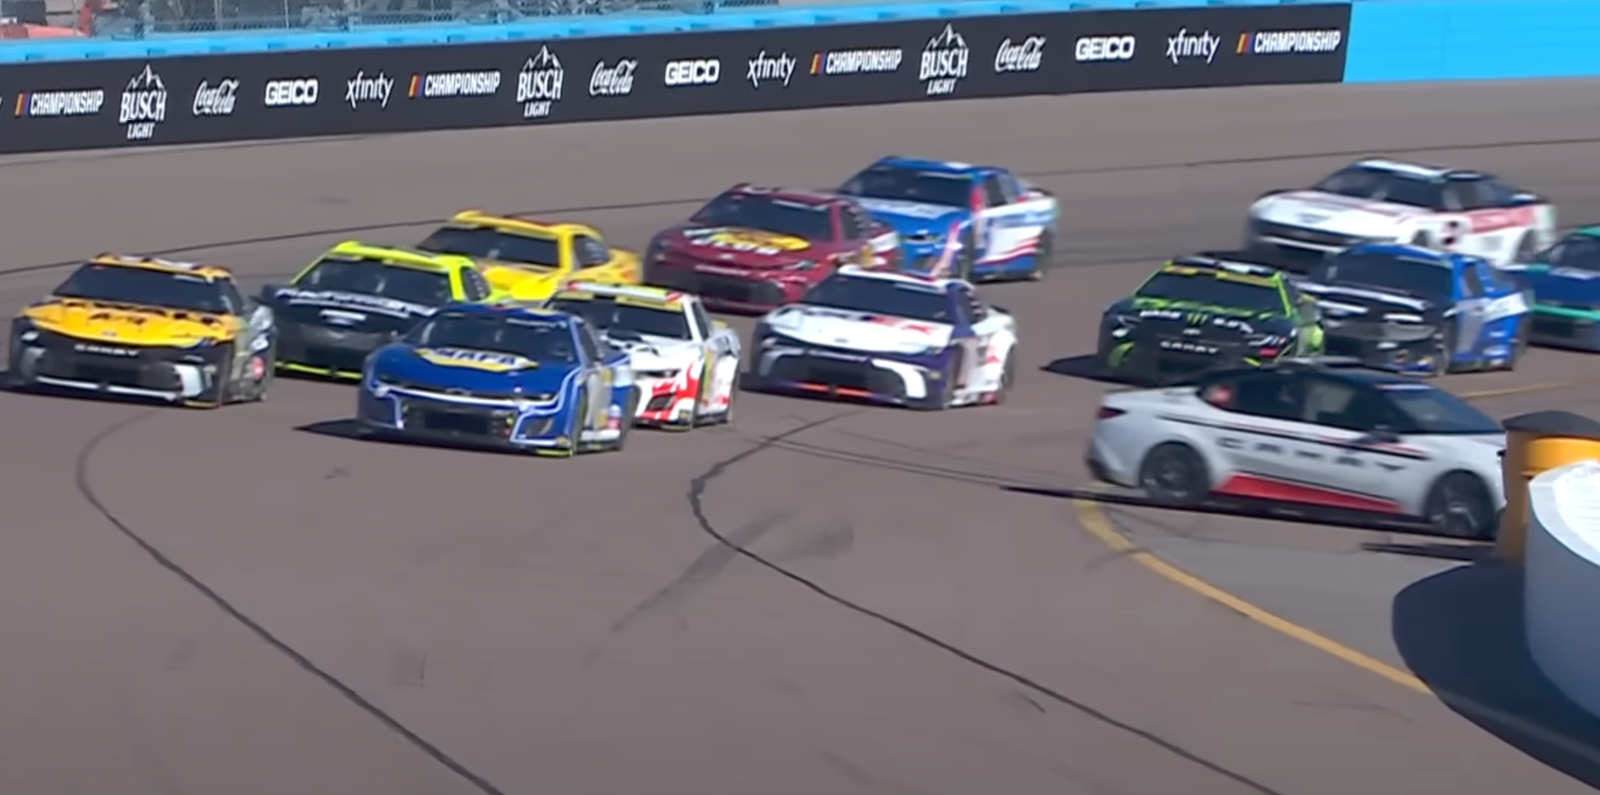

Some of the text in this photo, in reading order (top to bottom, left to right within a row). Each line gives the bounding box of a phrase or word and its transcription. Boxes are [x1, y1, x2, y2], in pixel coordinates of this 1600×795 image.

[1074, 35, 1136, 61] GEICO
[1165, 28, 1221, 65] xfinity
[1253, 30, 1342, 54] CHAMPIONSHIP
[664, 59, 721, 86] GEICO
[746, 50, 797, 88] xfinity
[825, 48, 903, 75] CHAMPIONSHIP
[918, 48, 970, 80] BUSCH
[264, 78, 319, 106] GEICO
[345, 70, 394, 109] xfinity
[424, 70, 501, 97] CHAMPIONSHIP
[516, 69, 564, 103] BUSCH
[926, 77, 957, 95] LIGHT
[29, 89, 104, 116] CHAMPIONSHIP
[119, 90, 168, 124] BUSCH
[523, 100, 552, 118] LIGHT
[127, 122, 156, 140] LIGHT
[1215, 434, 1406, 473] CAMRY
